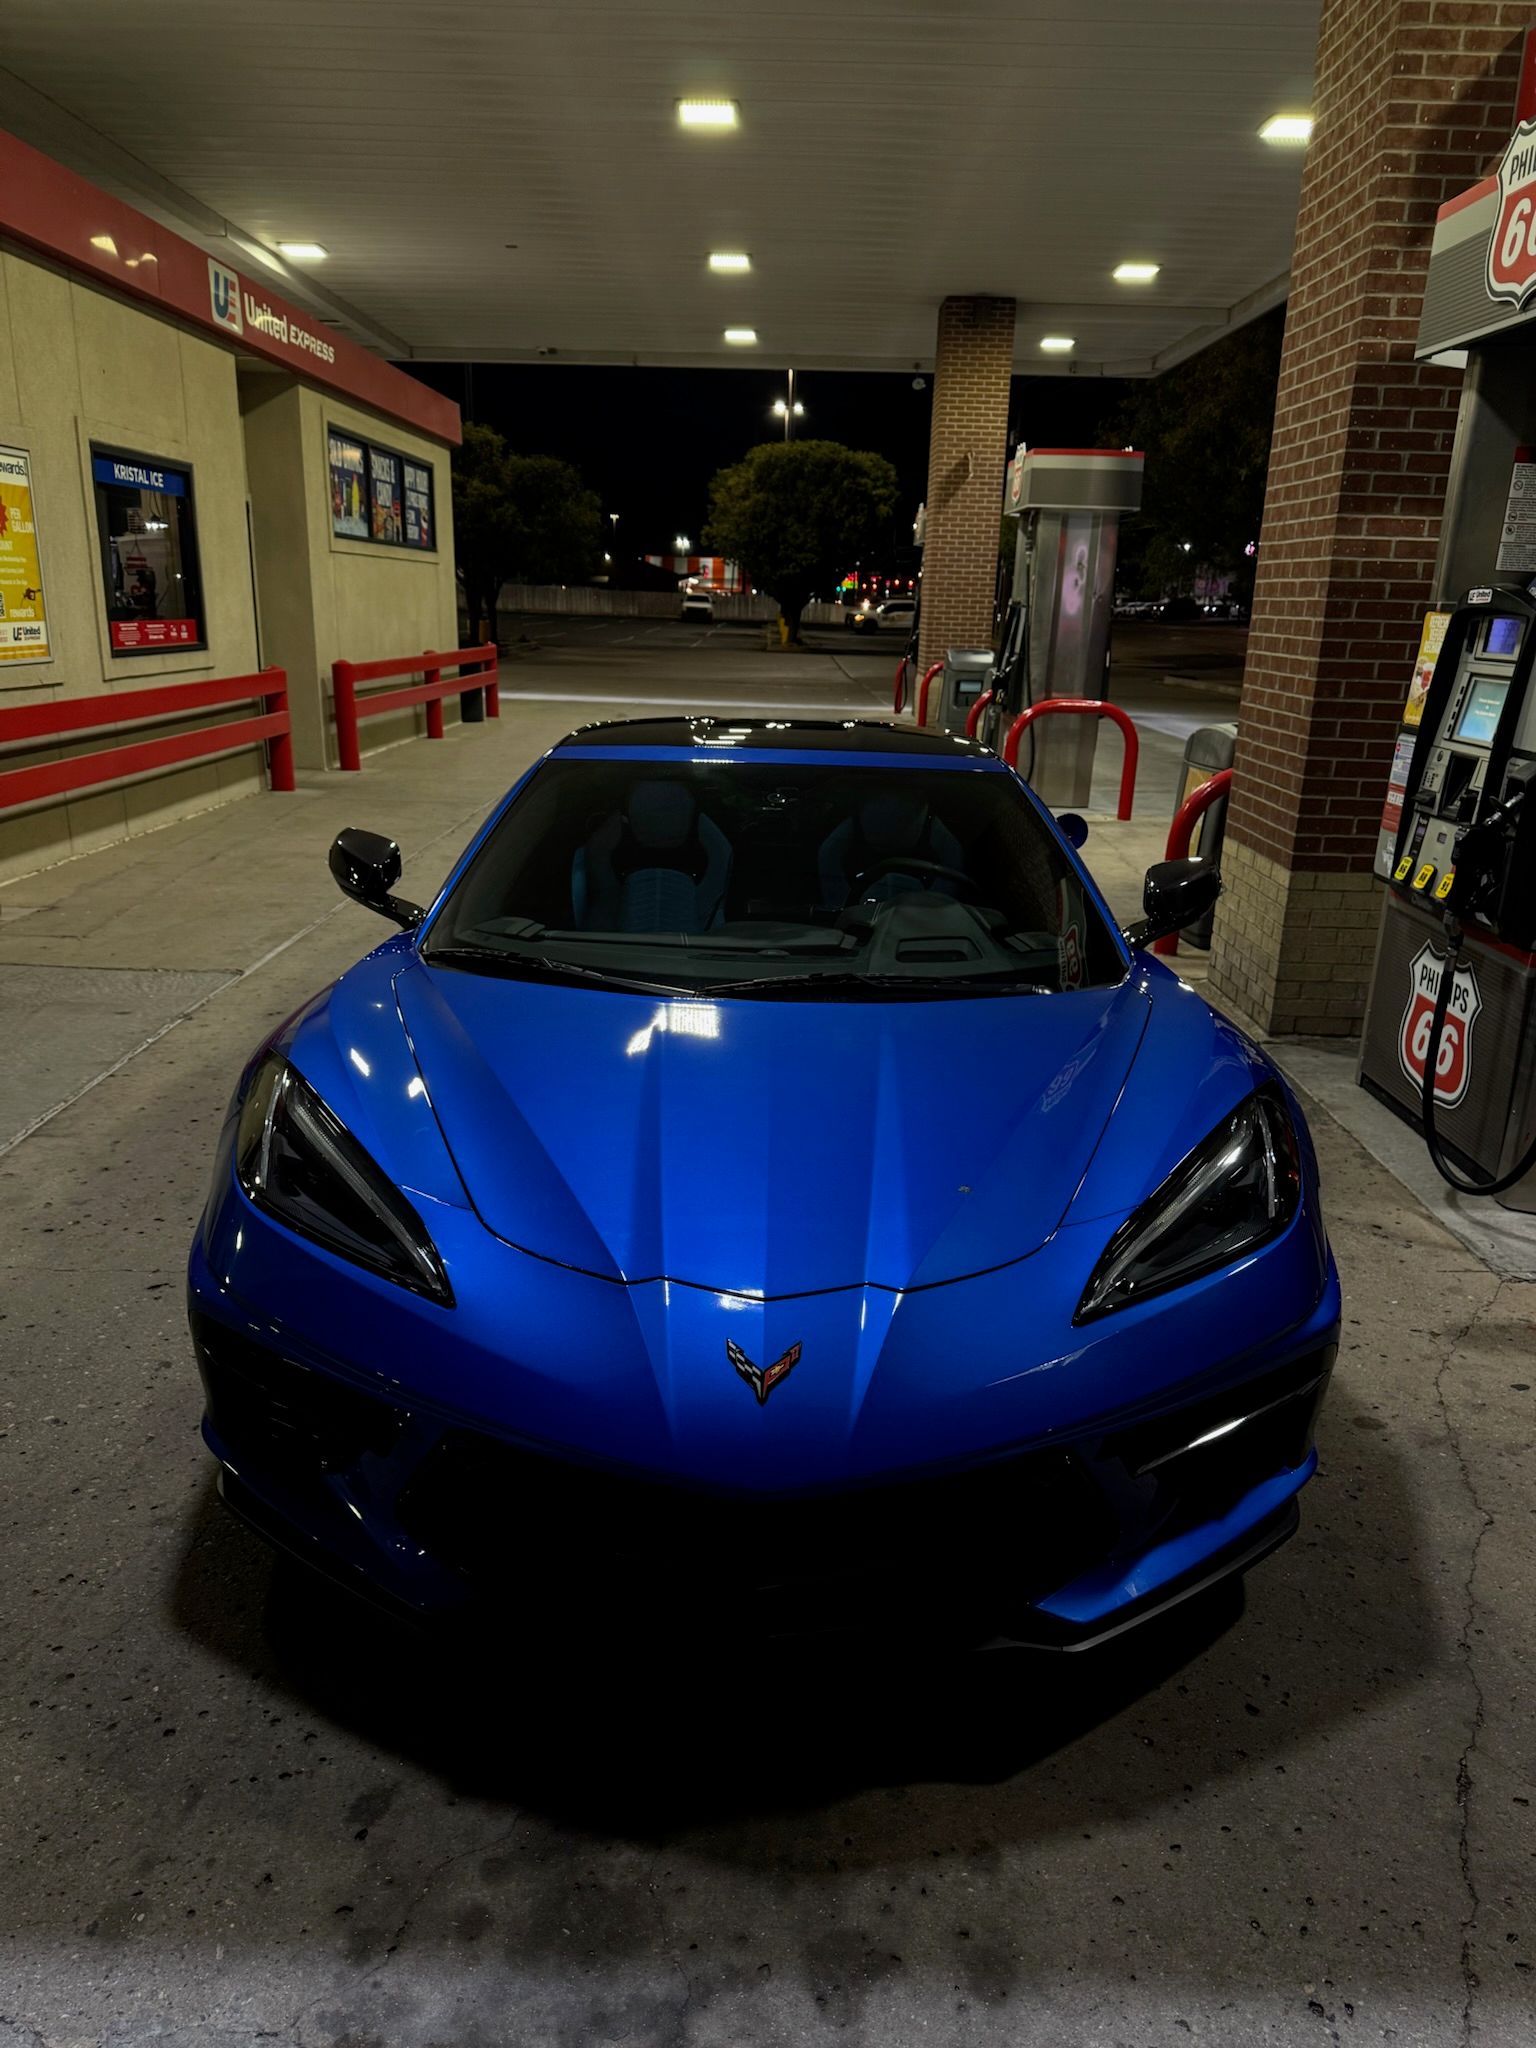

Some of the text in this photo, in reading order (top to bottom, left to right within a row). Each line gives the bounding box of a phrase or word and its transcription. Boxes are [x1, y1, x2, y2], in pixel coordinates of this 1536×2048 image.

[243, 291, 289, 344] United
[289, 323, 335, 364] EXPRESS
[113, 463, 165, 488] KRISTAL ICE
[1420, 963, 1469, 1014] PHIPS
[1411, 1010, 1459, 1075] 66
